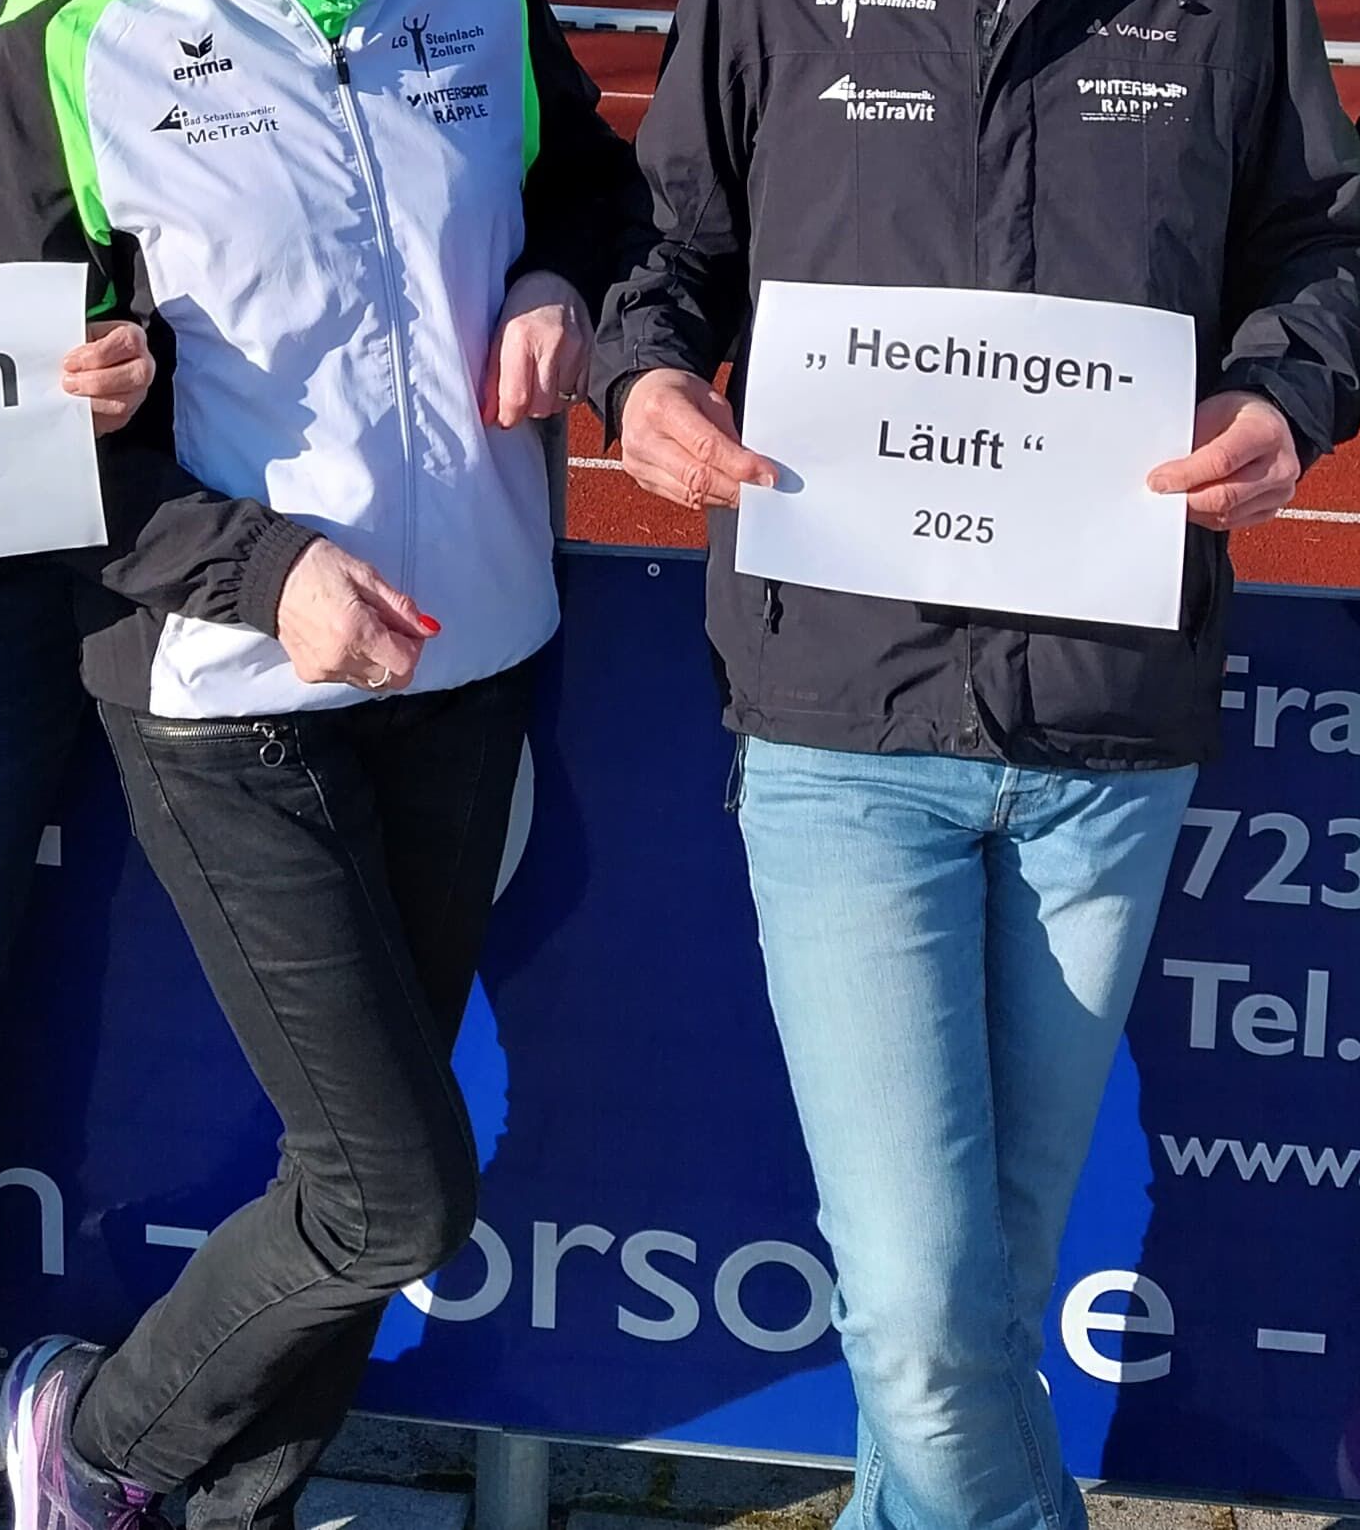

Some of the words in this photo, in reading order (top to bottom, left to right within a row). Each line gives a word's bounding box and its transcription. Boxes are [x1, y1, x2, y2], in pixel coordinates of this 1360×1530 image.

[392, 36, 408, 49] LG
[425, 25, 485, 45] Steinlach
[1116, 23, 1177, 42] VAUDE
[429, 43, 476, 58] Zollern
[173, 58, 233, 81] erima
[433, 103, 489, 124] RÄPPLE
[846, 101, 936, 121] MeTraVit
[186, 118, 280, 145] MeTraVit
[846, 326, 1134, 395] Hechingen-
[877, 419, 1004, 470] Läuft
[912, 508, 995, 545] 2025
